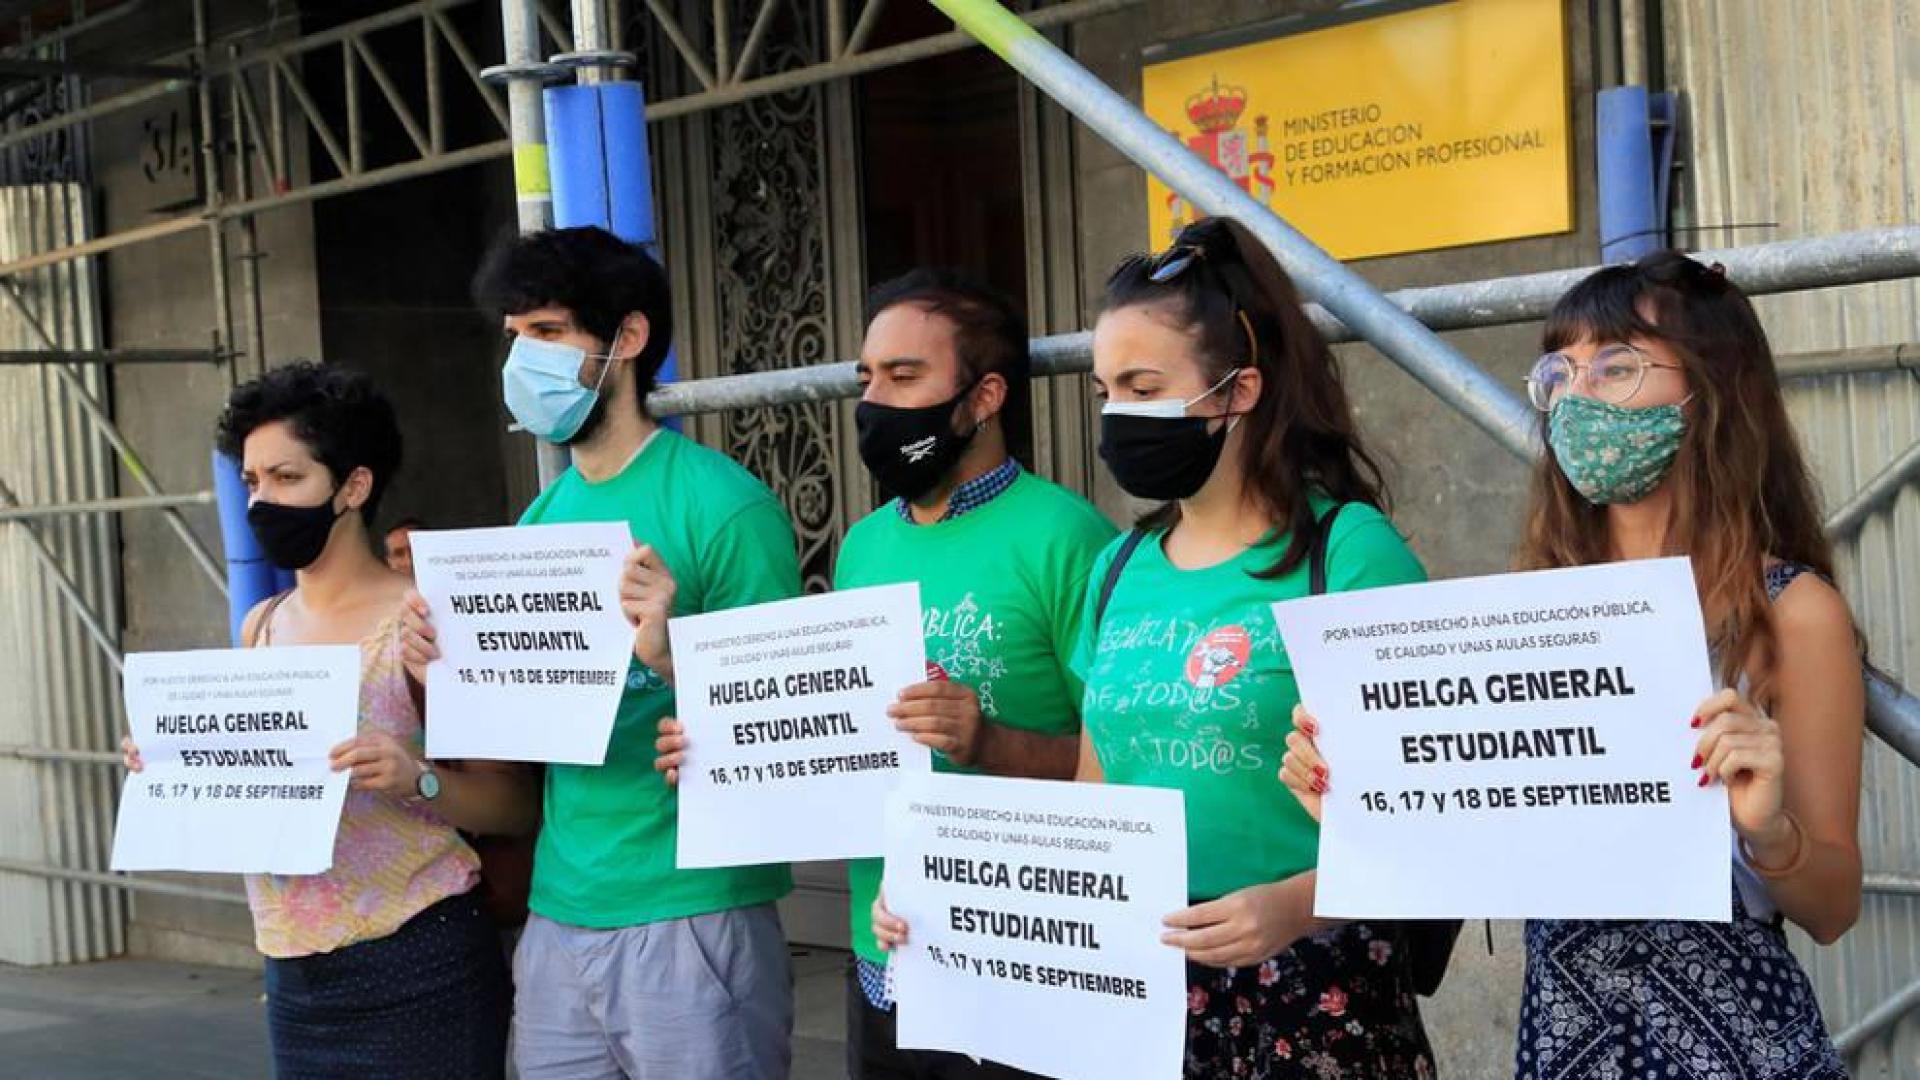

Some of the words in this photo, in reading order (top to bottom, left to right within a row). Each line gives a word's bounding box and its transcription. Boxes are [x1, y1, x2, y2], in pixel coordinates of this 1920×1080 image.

[1284, 103, 1381, 137] MINISTERIO
[1285, 141, 1306, 162] DE
[1285, 169, 1296, 187] Y
[1415, 129, 1545, 167] PROFESIONAL
[451, 594, 518, 614] HUELGA
[522, 591, 603, 613] GENERAL
[1352, 622, 1408, 638] NUESTRO
[1411, 616, 1468, 633] DERECHO
[1472, 616, 1480, 627] A
[1482, 613, 1510, 627] UNA
[1512, 604, 1589, 625] EDUCACIÓN
[477, 631, 589, 651] ESTUDIANTIL
[1375, 647, 1392, 660] DE
[1394, 643, 1445, 659] CALIDAD
[1448, 643, 1457, 654] Y
[1458, 640, 1492, 654] UNAS
[1496, 636, 1537, 651] AULAS
[480, 668, 495, 683] 17
[510, 668, 524, 683] 18
[527, 668, 543, 683] DE
[546, 668, 617, 685] SEPTIEMBRE
[709, 676, 780, 706] HUELGA
[785, 665, 874, 697] GENERAL
[1361, 676, 1477, 711] HUELGA
[1486, 666, 1635, 705] GENERAL
[156, 715, 219, 734] HUELGA
[224, 711, 308, 731] GENERAL
[733, 712, 858, 745] ESTUDIANTIL
[180, 749, 293, 767] ESTUDIANTIL
[1401, 727, 1606, 763] ESTUDIANTIL
[710, 767, 731, 785] 16,
[733, 765, 750, 781] 17
[766, 762, 785, 779] 18
[788, 760, 806, 776] DE
[809, 751, 899, 776] SEPTIEMBRE
[172, 783, 188, 798] 17
[206, 784, 222, 799] 18
[225, 784, 243, 799] DE
[246, 784, 324, 800] SEPTIEMBRE
[1361, 791, 1394, 814] 16,
[1400, 790, 1424, 810] 17
[1453, 788, 1481, 810] 18
[1489, 787, 1516, 807] DE
[1523, 782, 1671, 807] SEPTIEMBRE
[923, 805, 966, 818] NUESTRO
[967, 808, 1012, 823] DERECHO
[1014, 811, 1021, 822] A
[1024, 813, 1044, 825] UNA
[937, 825, 950, 838] DE
[952, 827, 991, 842] CALIDAD
[993, 831, 999, 841] Y
[1002, 832, 1029, 845] UNAS
[1032, 835, 1061, 849] AULAS
[923, 855, 1011, 889] HUELGA
[1018, 865, 1129, 902] GENERAL
[950, 906, 1100, 950] ESTUDIANTIL
[950, 952, 966, 971] 17
[986, 959, 1007, 978] 18
[1011, 963, 1033, 982] DE
[1037, 965, 1147, 1000] SEPTIEMBRE
